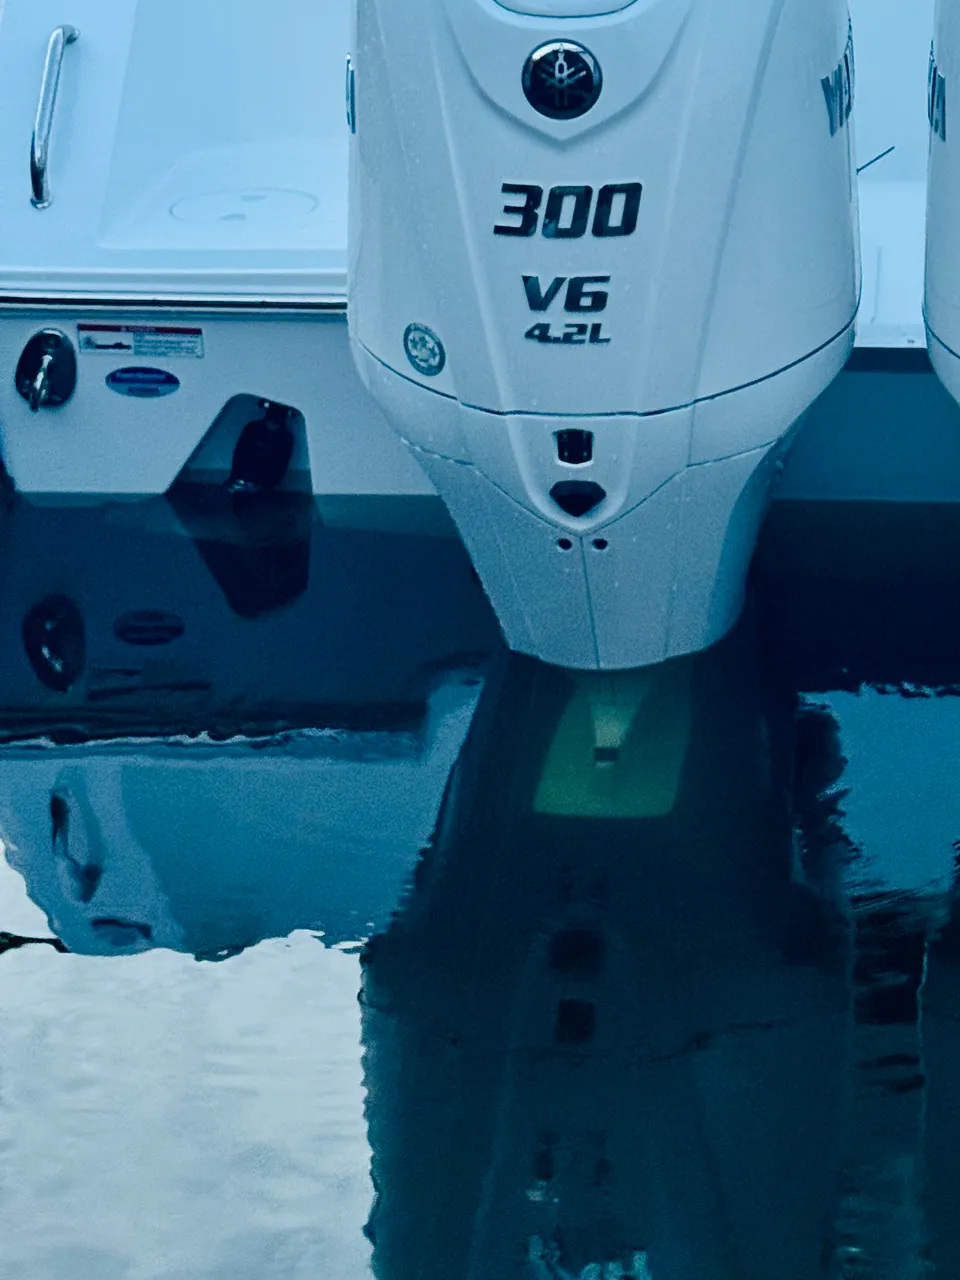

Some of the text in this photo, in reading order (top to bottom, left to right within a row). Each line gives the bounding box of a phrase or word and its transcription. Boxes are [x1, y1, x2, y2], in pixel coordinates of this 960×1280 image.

[492, 182, 643, 240] 300
[521, 275, 611, 314] V6
[523, 322, 611, 346] 4.2L
